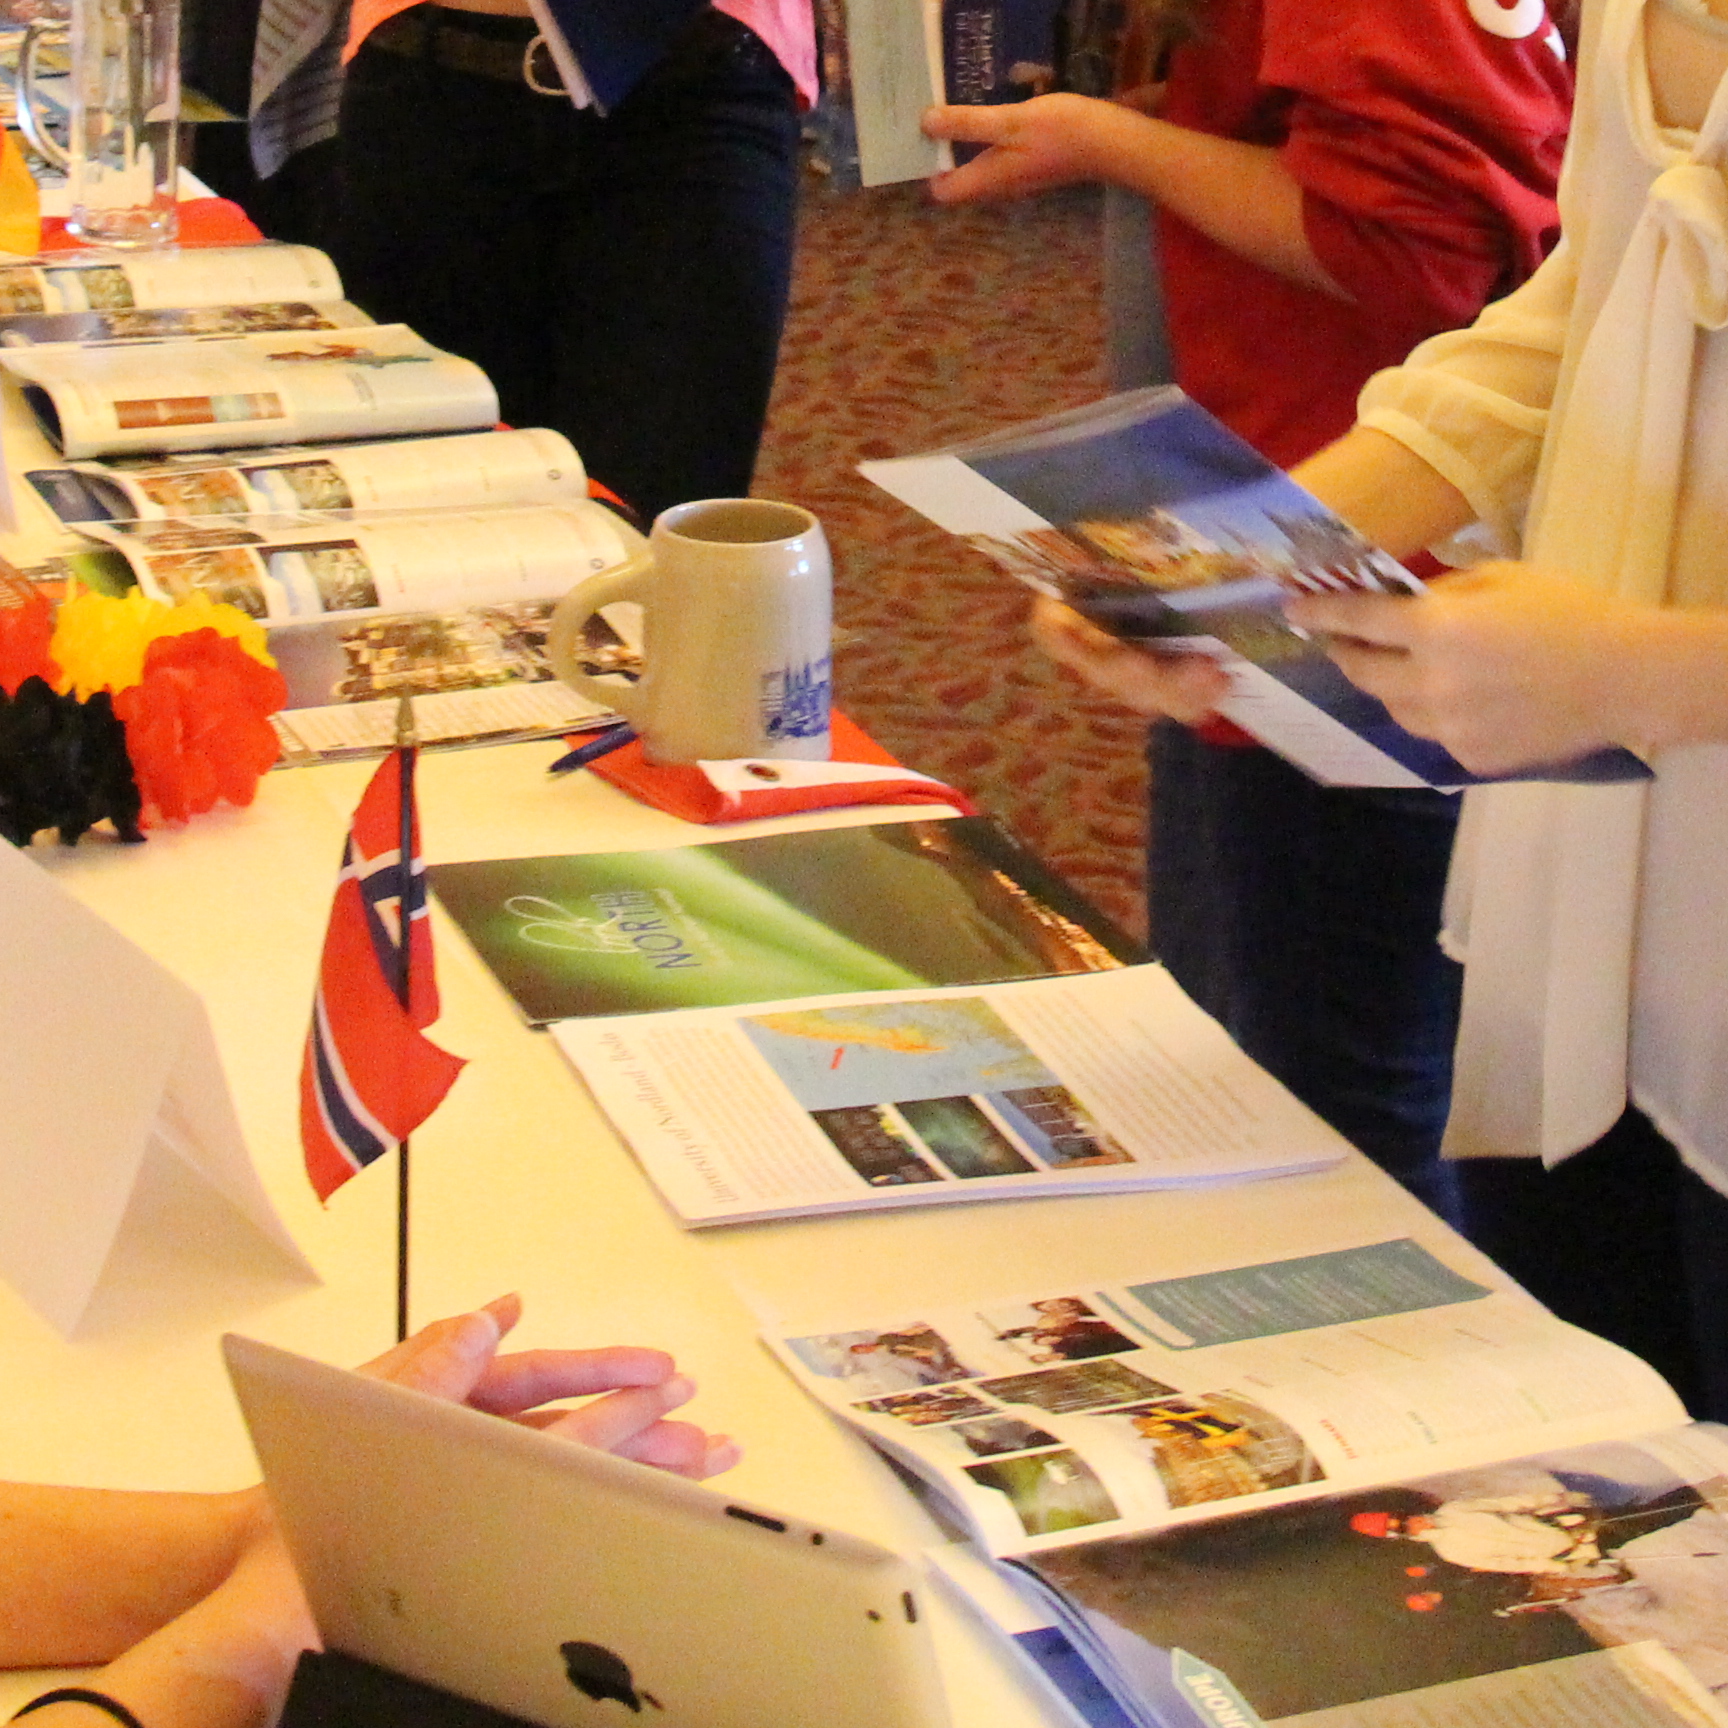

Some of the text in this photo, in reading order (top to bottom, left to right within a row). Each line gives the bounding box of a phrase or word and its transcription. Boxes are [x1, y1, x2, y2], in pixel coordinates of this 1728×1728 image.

[979, 10, 996, 91] CAPITAL
[620, 1069, 677, 1127] Nordland
[683, 1144, 740, 1204] University
